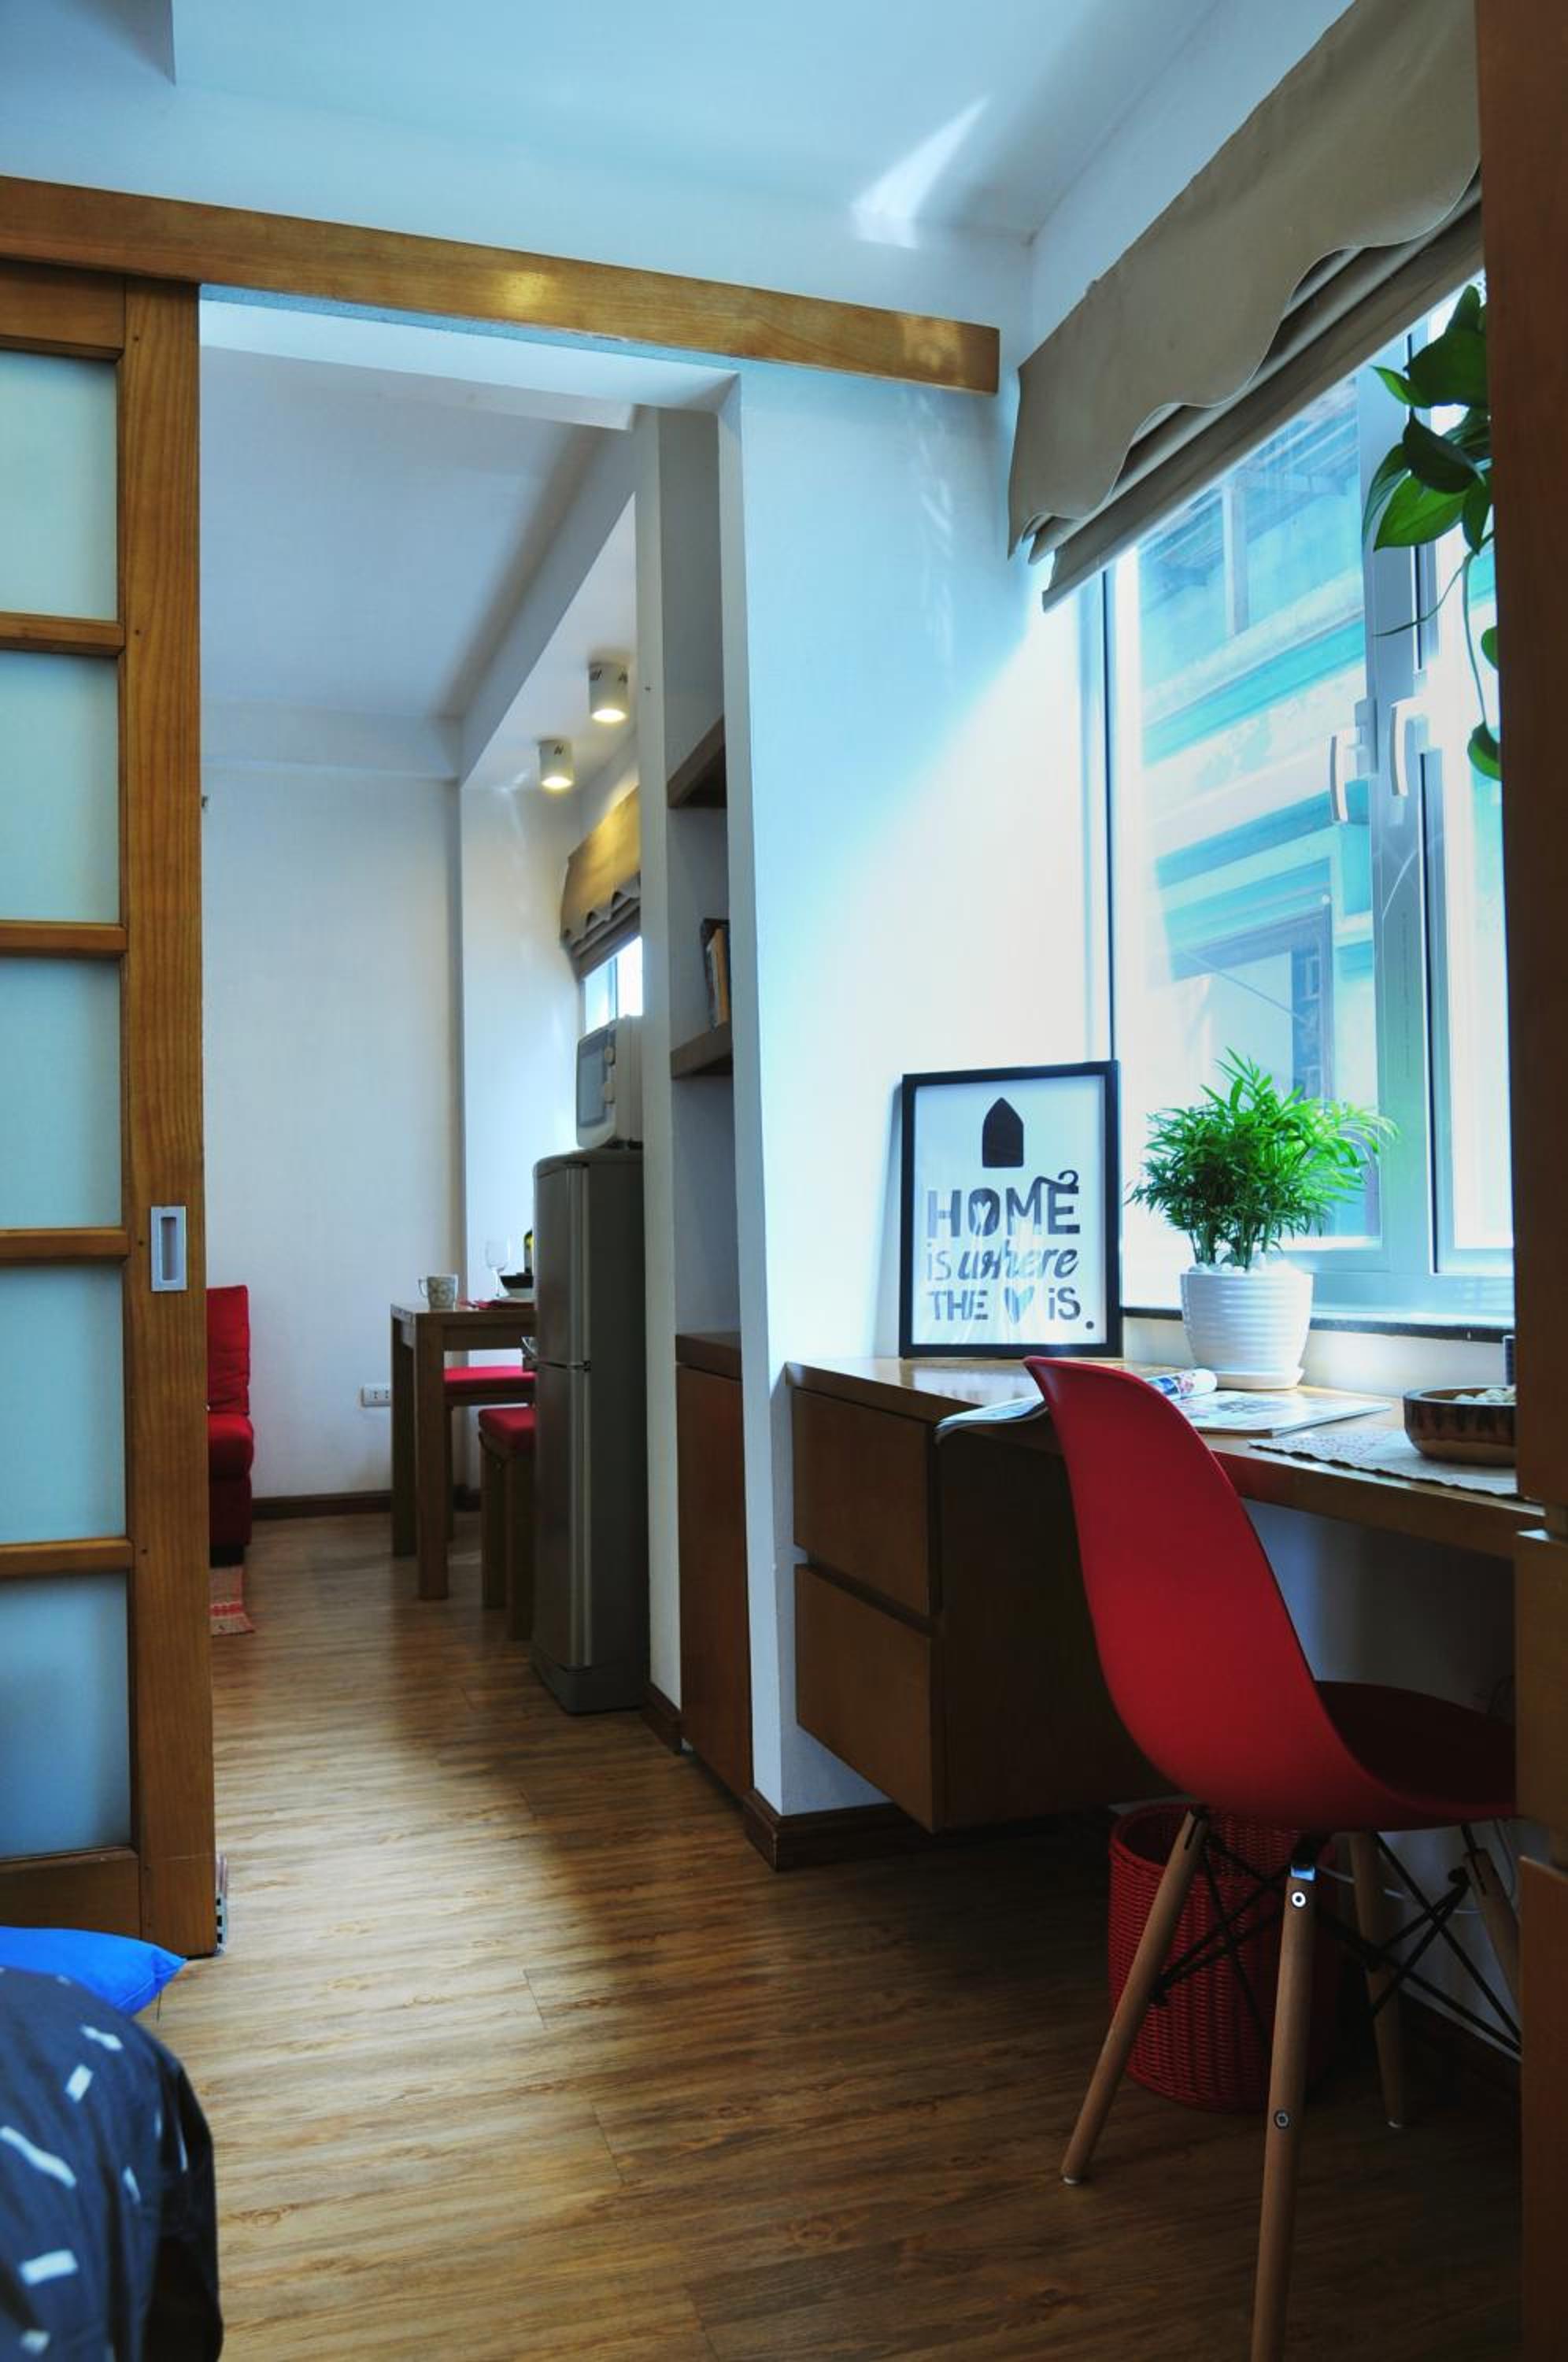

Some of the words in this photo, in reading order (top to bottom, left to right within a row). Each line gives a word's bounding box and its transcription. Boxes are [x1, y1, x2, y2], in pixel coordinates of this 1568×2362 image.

[926, 1170, 1080, 1238] HOME
[957, 1240, 1078, 1280] where
[928, 1290, 989, 1320] THE
